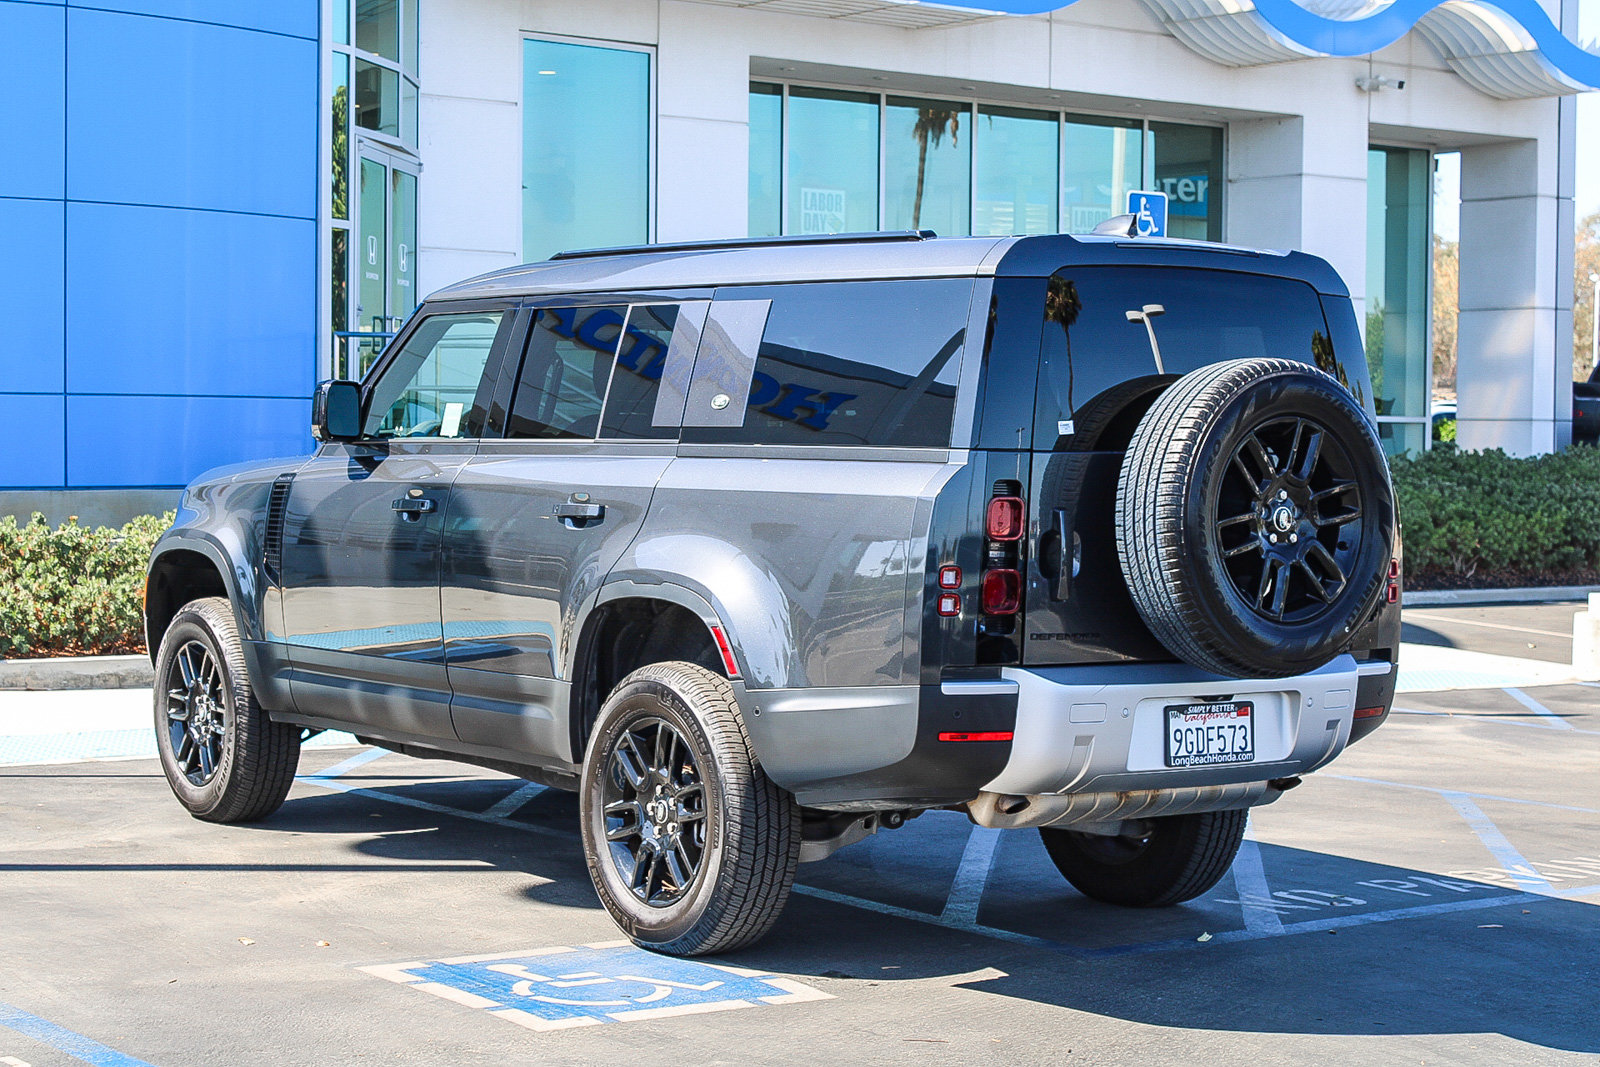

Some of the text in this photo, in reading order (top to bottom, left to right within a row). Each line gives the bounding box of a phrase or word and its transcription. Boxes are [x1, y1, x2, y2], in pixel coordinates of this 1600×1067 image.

[804, 191, 842, 212] LABOR
[804, 212, 827, 232] DAY
[1187, 703, 1235, 714] SIMPLY BETTER
[672, 700, 708, 755] MICHELIN
[1173, 724, 1248, 756] 9GDF573
[1171, 752, 1254, 768] LongBeachHonda.com
